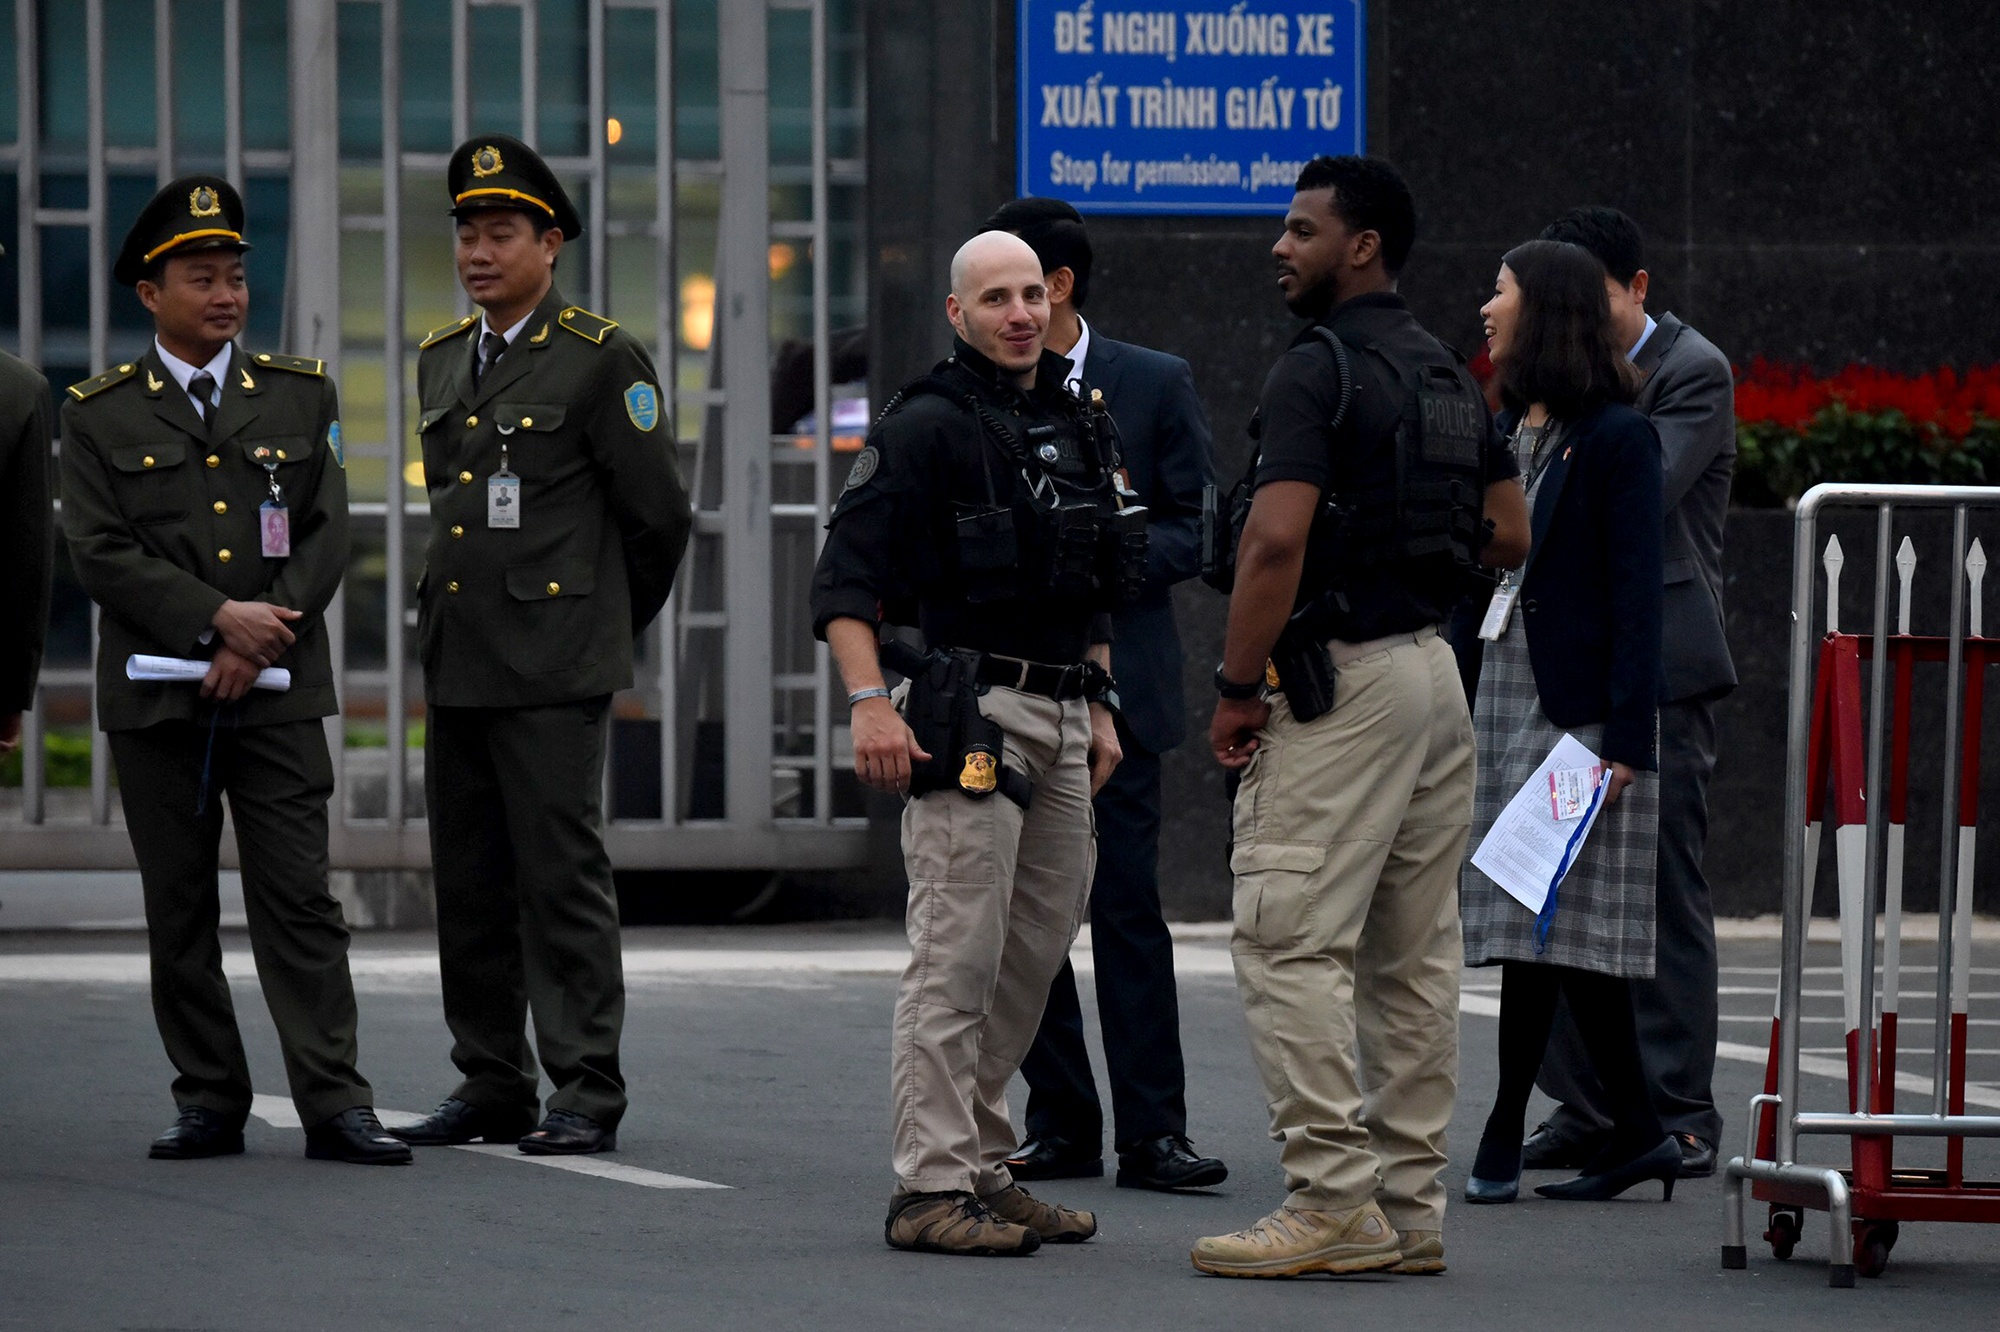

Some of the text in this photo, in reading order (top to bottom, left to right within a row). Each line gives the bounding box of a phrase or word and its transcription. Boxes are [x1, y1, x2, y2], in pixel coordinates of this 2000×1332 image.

[1103, 11, 1177, 63] NGHỊ
[1185, 1, 1289, 56] XUỐNG
[1296, 13, 1335, 56] XE
[1041, 71, 1342, 130] XUẤT TRÌNH GIẤY TỜ
[1050, 150, 1097, 193] Stop
[1101, 150, 1131, 186] for
[1423, 397, 1478, 439] POLICE
